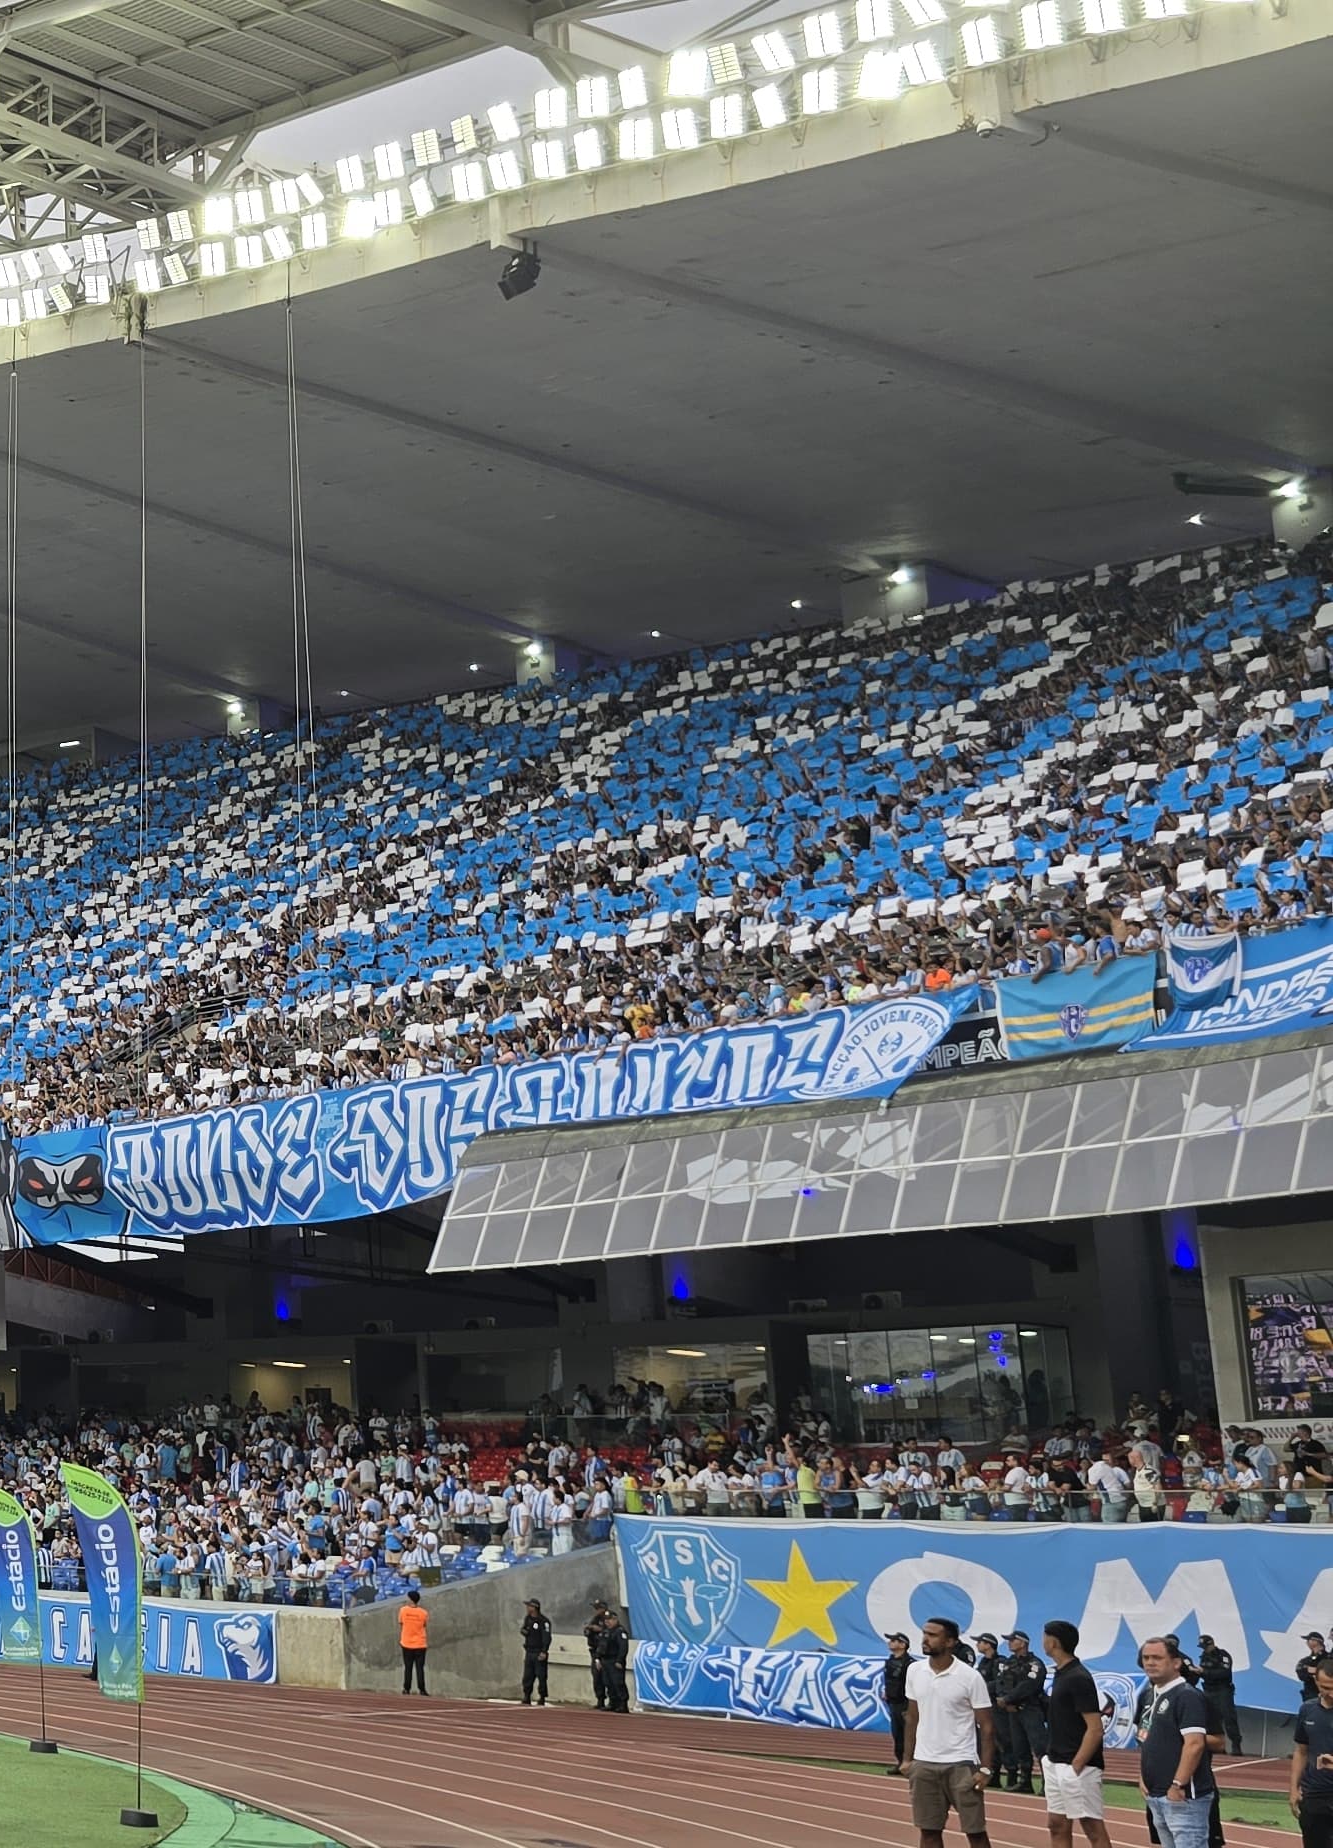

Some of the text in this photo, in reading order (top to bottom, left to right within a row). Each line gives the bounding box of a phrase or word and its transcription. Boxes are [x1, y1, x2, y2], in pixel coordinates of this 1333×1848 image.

[864, 1009, 910, 1037] JOVEM
[113, 1102, 319, 1218] BONDE
[643, 1538, 731, 1582] PSC
